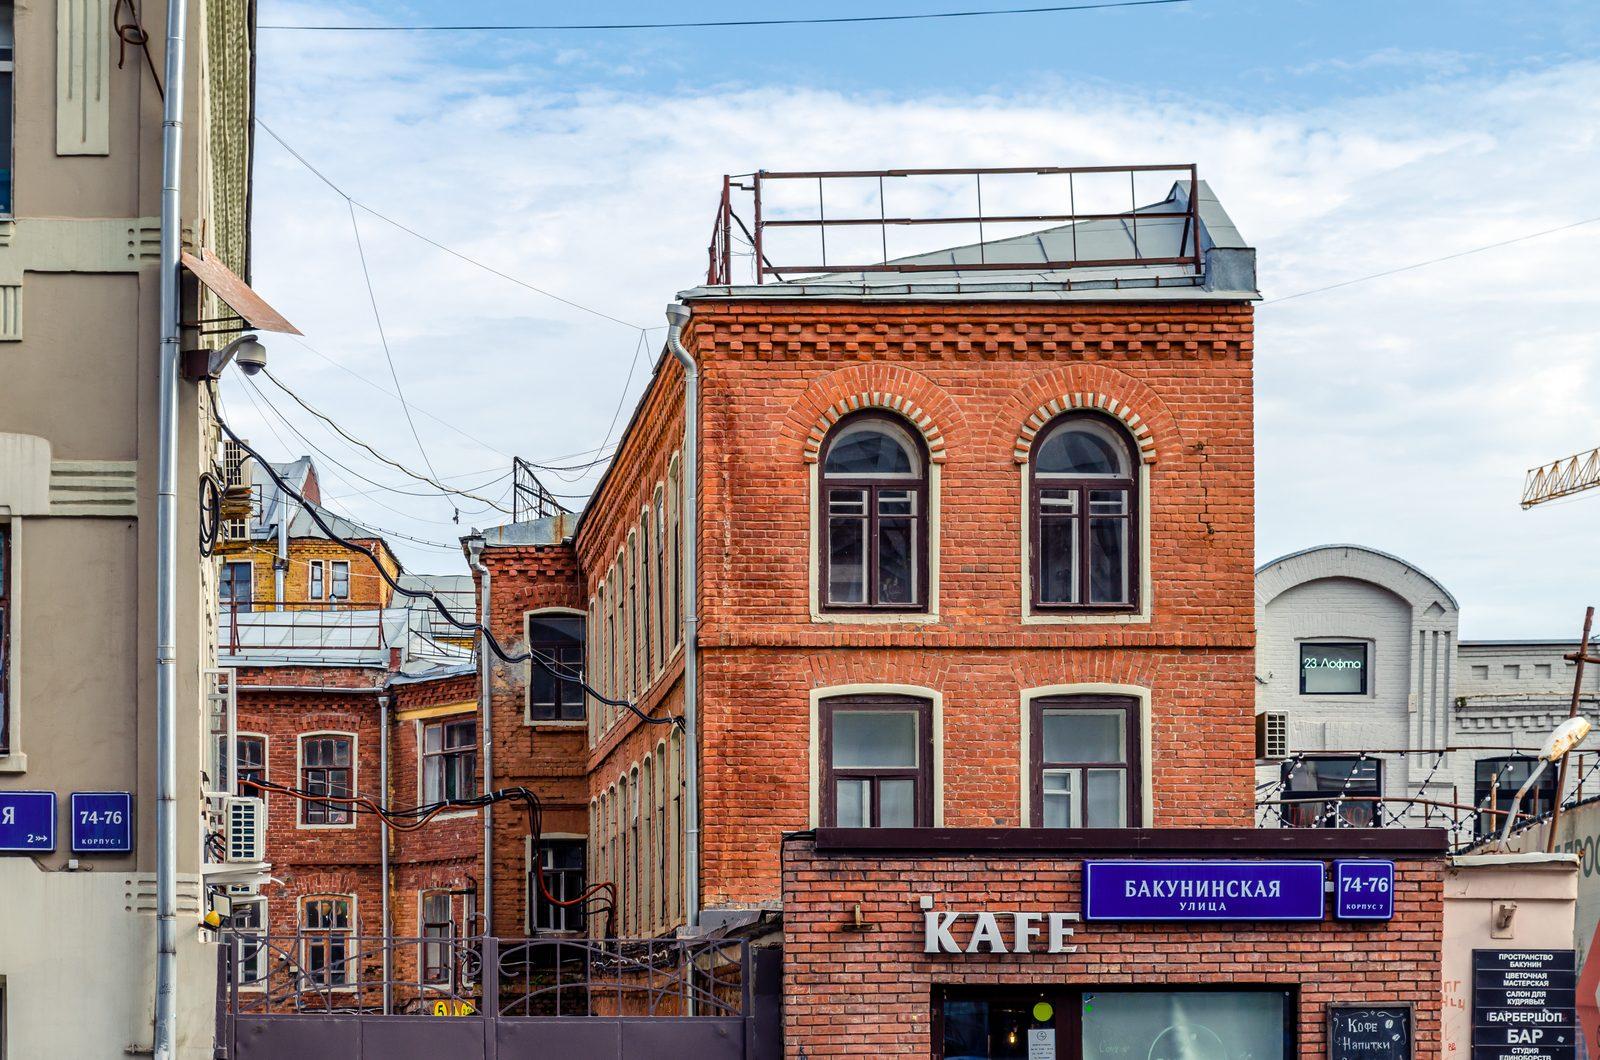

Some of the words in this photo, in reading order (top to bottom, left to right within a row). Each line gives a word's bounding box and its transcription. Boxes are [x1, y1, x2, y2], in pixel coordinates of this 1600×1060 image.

[1304, 658, 1317, 669] 23
[80, 811, 122, 825] 74-76
[1124, 880, 1281, 898] БАКУНИНСКАЯ
[1342, 877, 1389, 893] 74-76
[1179, 902, 1227, 911] УЛИЦА
[924, 911, 1080, 953] KAFE
[1498, 953, 1553, 961] ПРОСТРАНСТВО
[1489, 1012, 1562, 1022] БАРБЕРШОП
[1507, 1029, 1543, 1043] БАР
[1511, 1047, 1539, 1055] СТУДИЯ
